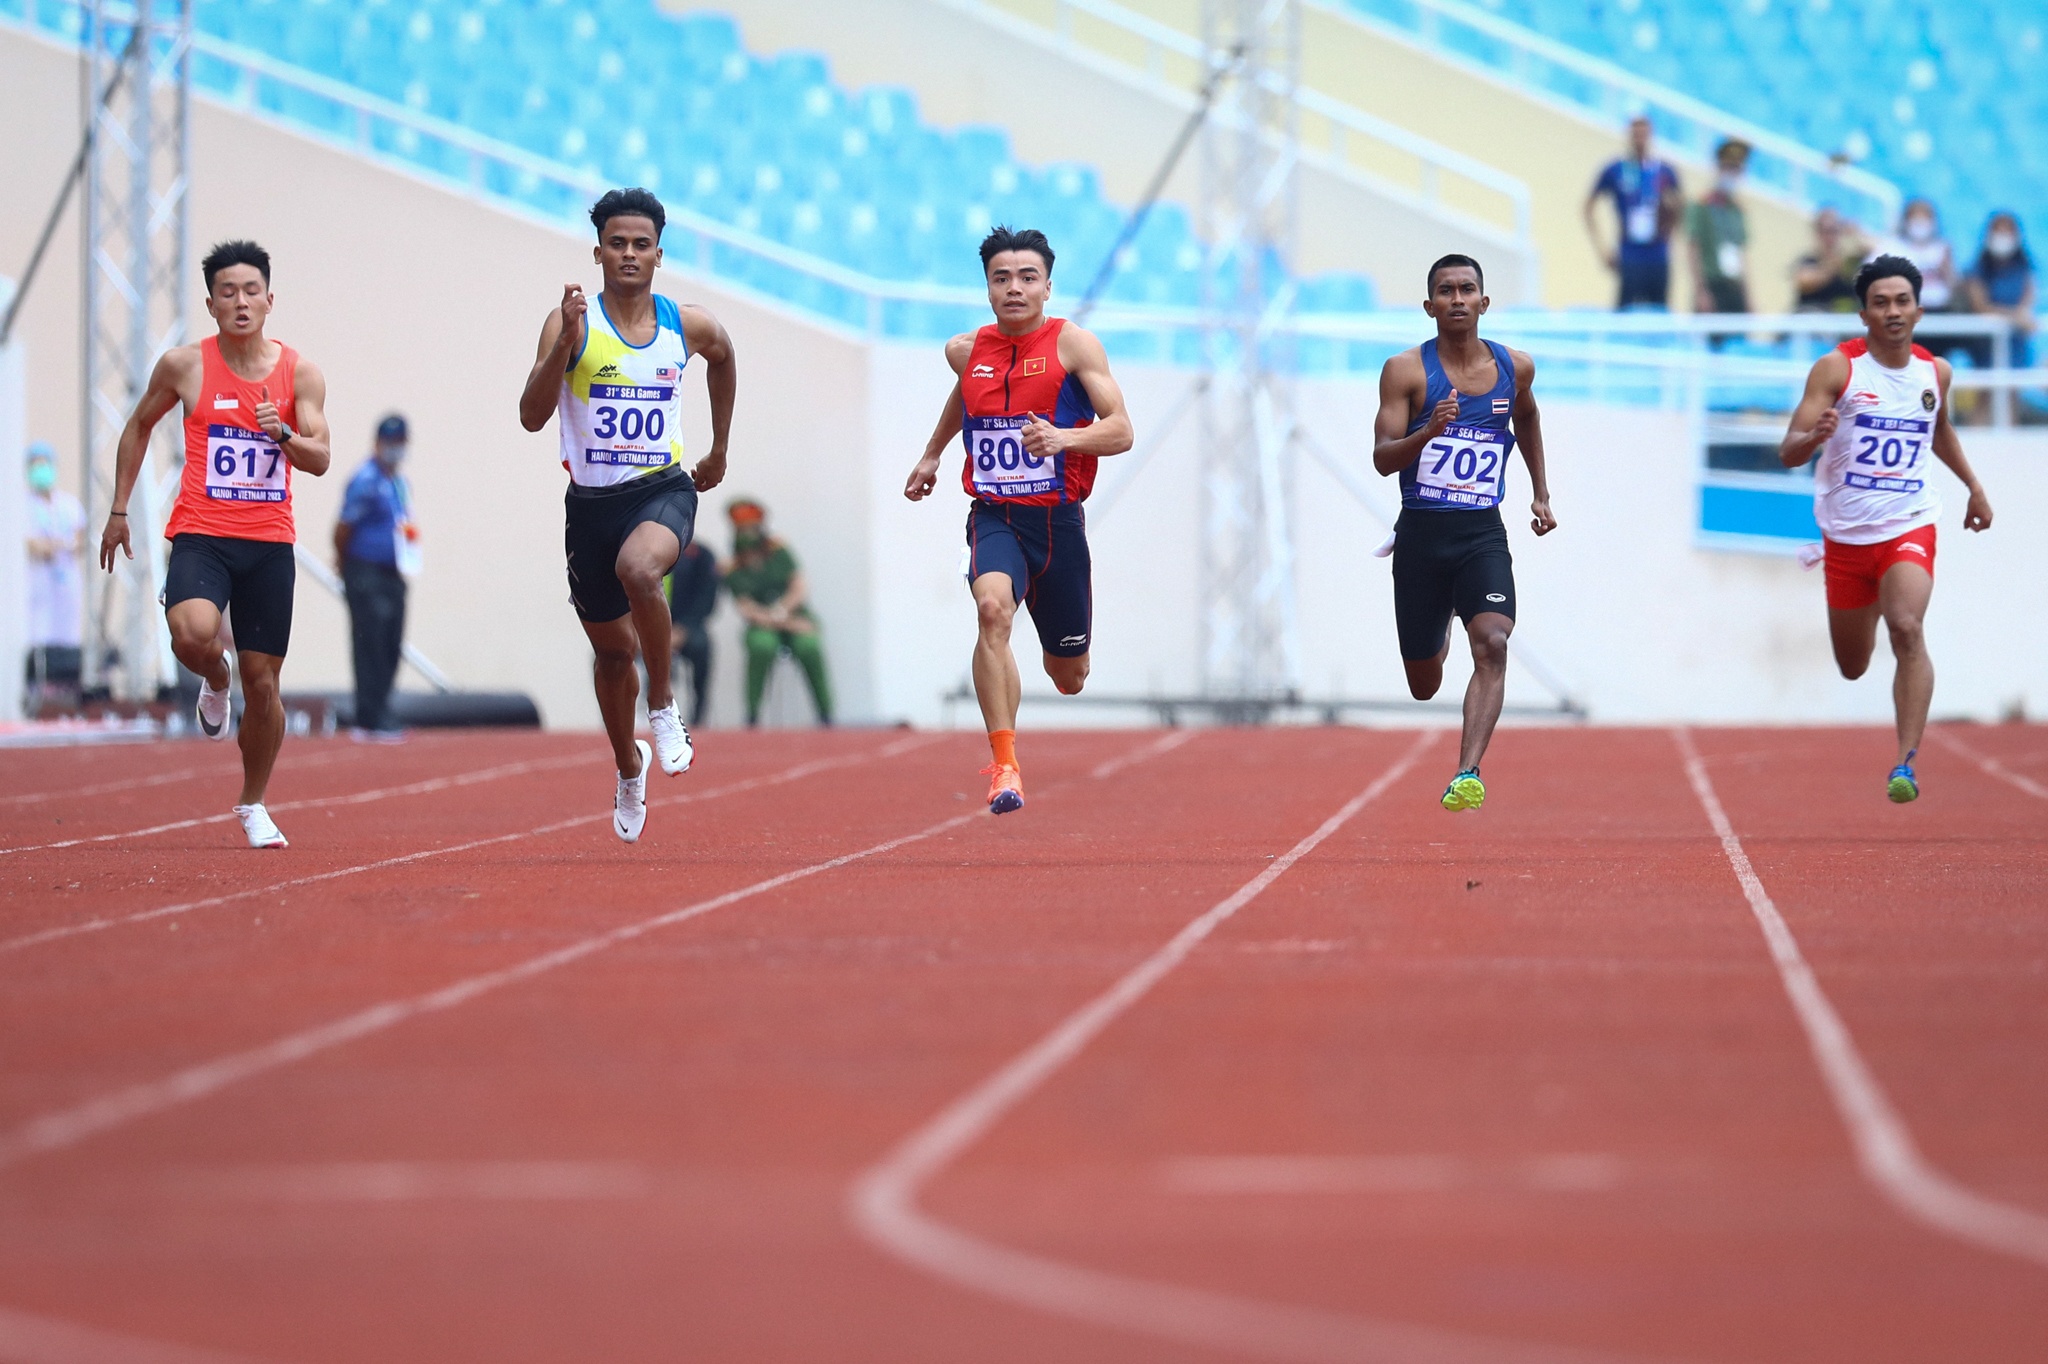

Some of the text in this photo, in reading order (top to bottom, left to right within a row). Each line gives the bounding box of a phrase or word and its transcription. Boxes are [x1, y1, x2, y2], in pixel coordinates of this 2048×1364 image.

[620, 388, 636, 398] SEA
[637, 389, 661, 399] Games
[594, 406, 665, 441] 300
[993, 419, 1009, 428] SEA
[238, 429, 252, 439] SEA
[1458, 428, 1473, 439] SEA
[591, 452, 612, 462] HANOI
[617, 453, 648, 464] VIETNAM
[648, 454, 665, 464] 2022
[1856, 435, 1921, 469] 207
[214, 445, 281, 479] 617
[1431, 443, 1498, 483] 702
[211, 488, 232, 499] HANOI
[237, 490, 266, 500] VIETNAM
[267, 491, 282, 501] 2022
[1001, 483, 1032, 495] VIETNAM
[1032, 481, 1051, 492] 2022
[1419, 486, 1442, 499] HANOI
[1447, 491, 1478, 505] VIETNAM
[1477, 495, 1494, 506] 2022
